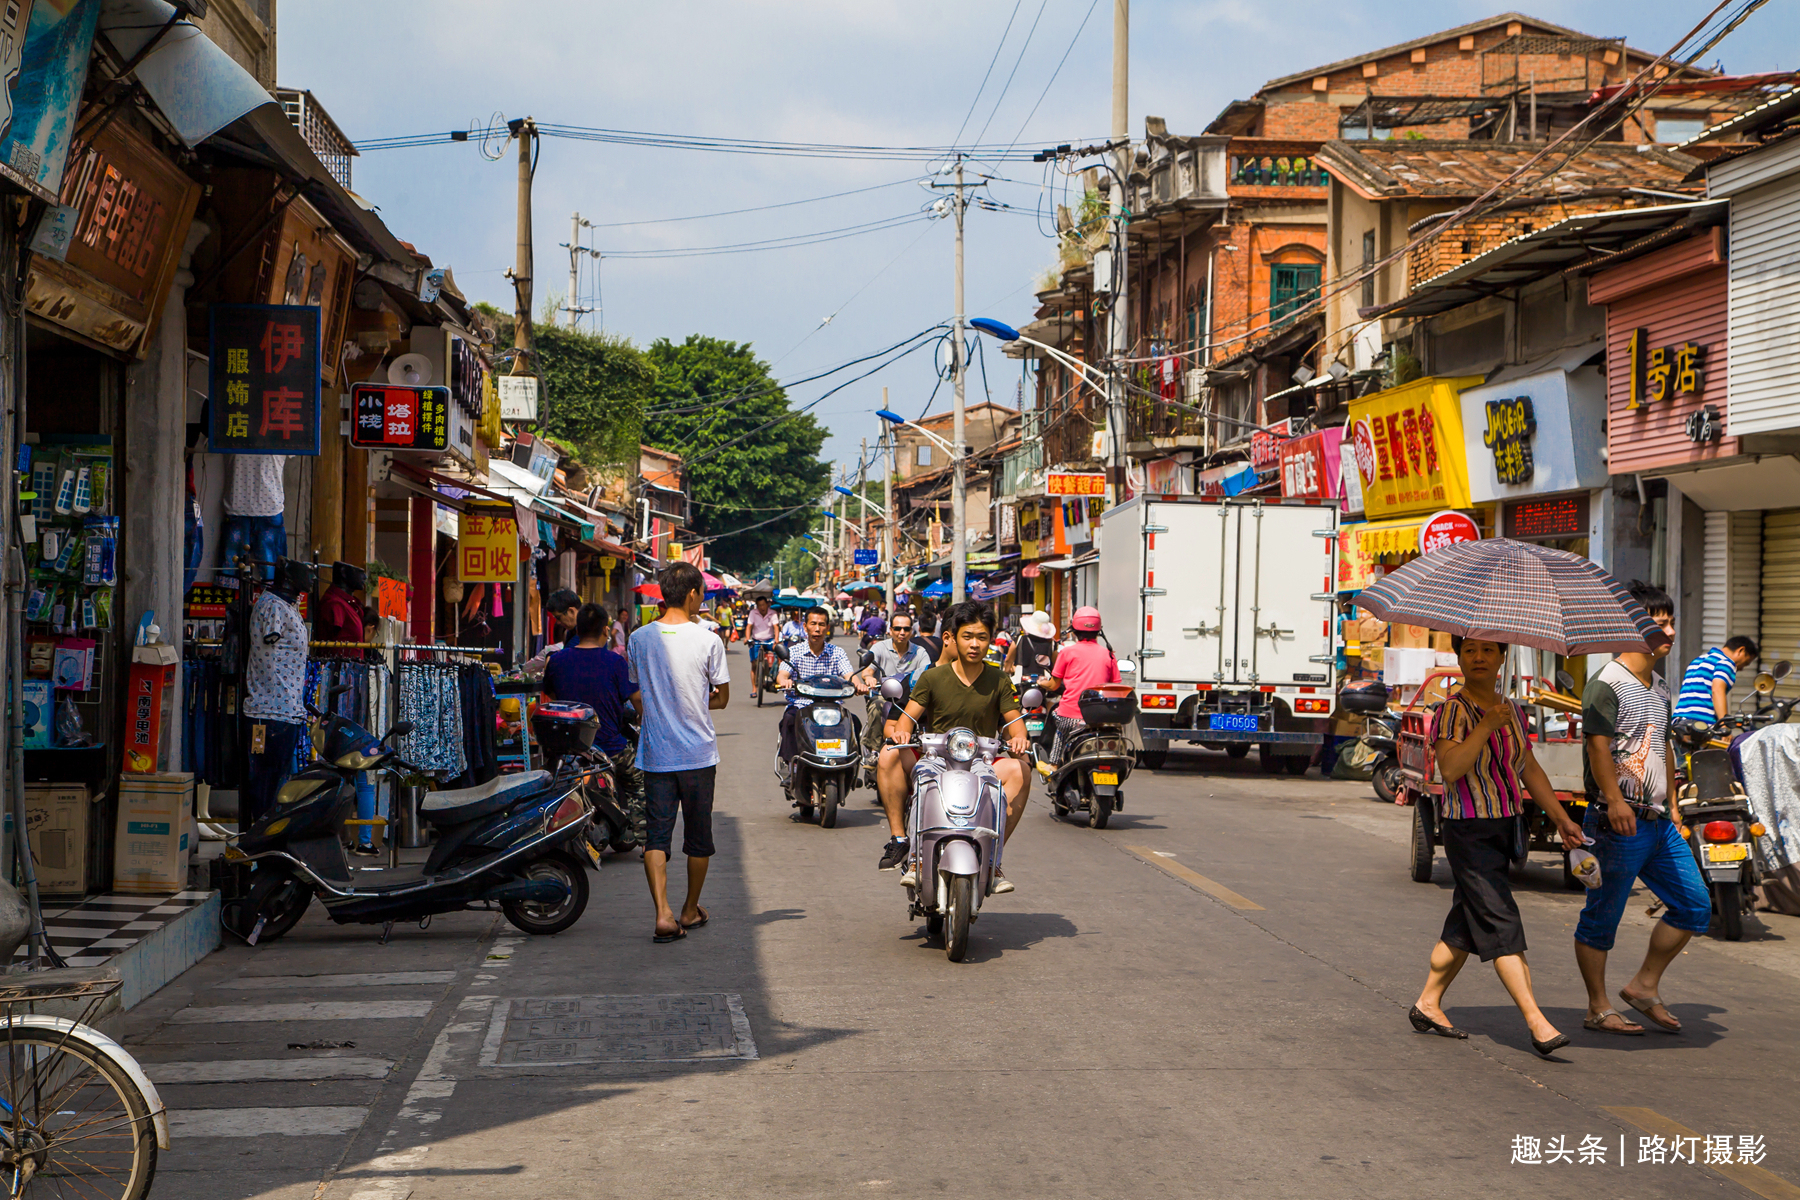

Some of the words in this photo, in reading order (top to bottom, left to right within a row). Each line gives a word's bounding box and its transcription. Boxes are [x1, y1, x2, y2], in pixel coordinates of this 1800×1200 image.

[259, 320, 305, 440] 伊库
[1626, 328, 1700, 410] 1号店
[226, 348, 250, 438] 服饰店
[422, 389, 433, 433] 绿植摆件
[434, 403, 445, 446] 多肉植物
[1049, 475, 1105, 494] 快餐超市
[1431, 522, 1454, 532] SNACK
[464, 547, 512, 577] 回收
[135, 696, 153, 744] 南孚电池
